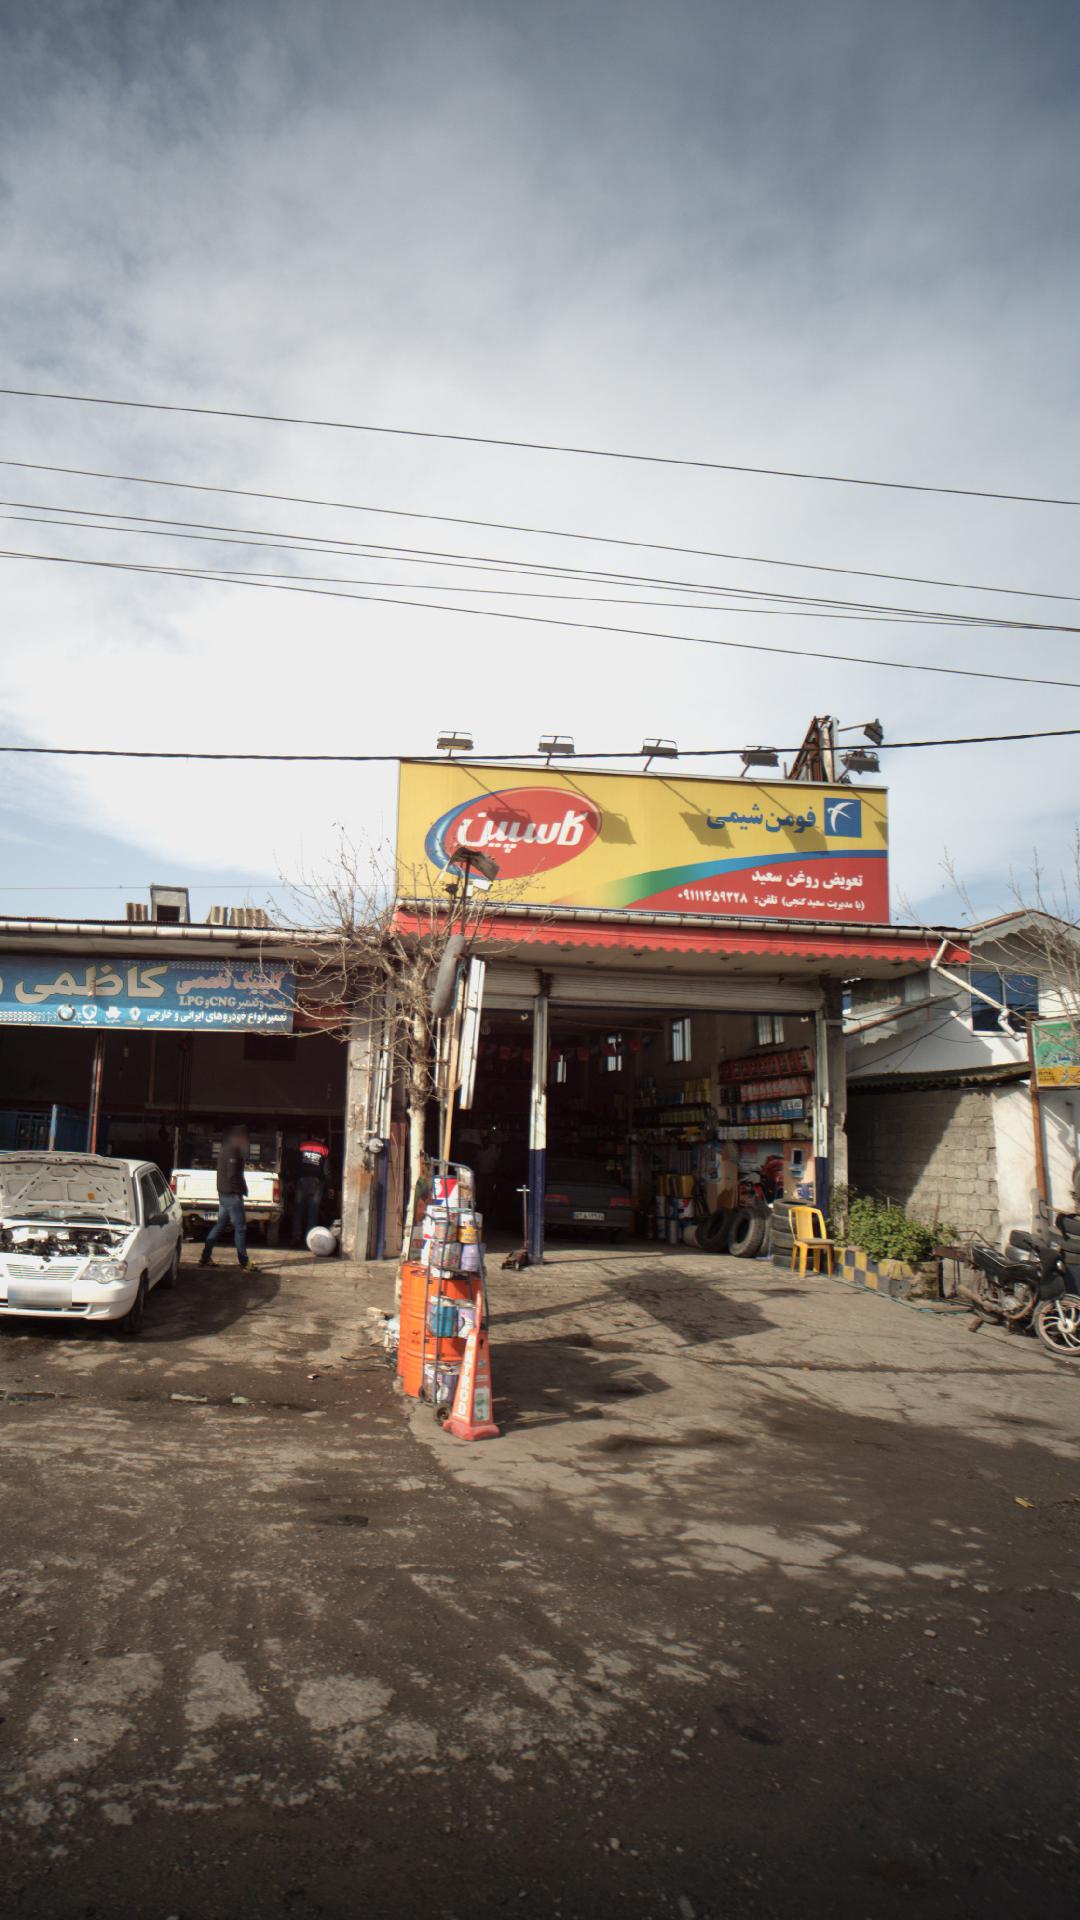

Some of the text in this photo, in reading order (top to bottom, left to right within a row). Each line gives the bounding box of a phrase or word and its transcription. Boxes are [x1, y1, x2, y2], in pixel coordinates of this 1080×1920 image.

[706, 803, 816, 833] فومن شیمی
[457, 810, 588, 854] کاسپین
[751, 870, 864, 890] تعویض روغن سعید
[754, 893, 778, 908] تلفن:
[826, 900, 854, 910] مدیریت
[15, 965, 168, 1004] کاظمی
[179, 995, 204, 1007] LPG
[209, 996, 236, 1007] CNG
[147, 1010, 173, 1022] خارجی
[180, 1010, 205, 1024] ایرانی
[205, 1010, 246, 1025] خودروهای
[247, 1011, 267, 1025] انواع
[267, 1011, 288, 1025] تعمیر
